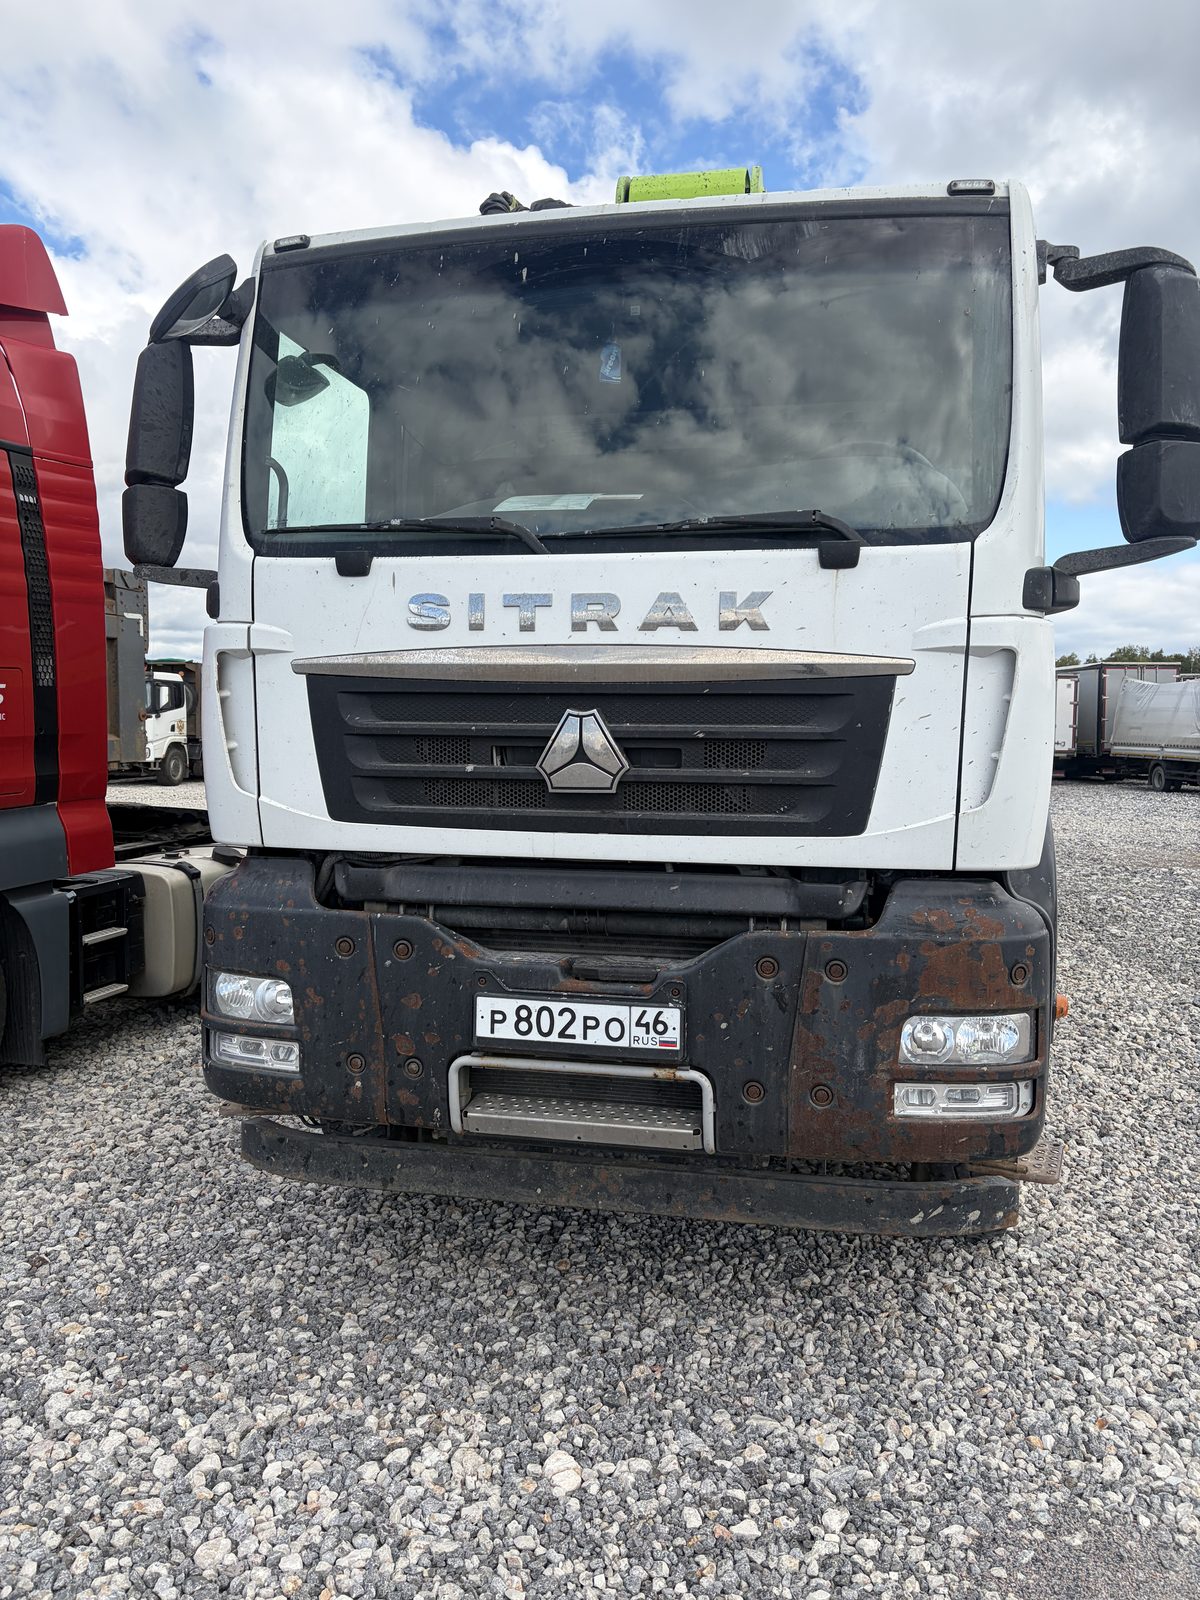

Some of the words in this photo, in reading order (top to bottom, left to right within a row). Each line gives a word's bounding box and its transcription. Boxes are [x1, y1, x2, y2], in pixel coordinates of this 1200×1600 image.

[407, 591, 774, 632] SITRAK
[635, 1009, 669, 1036] 46
[632, 1035, 658, 1047] RUS
